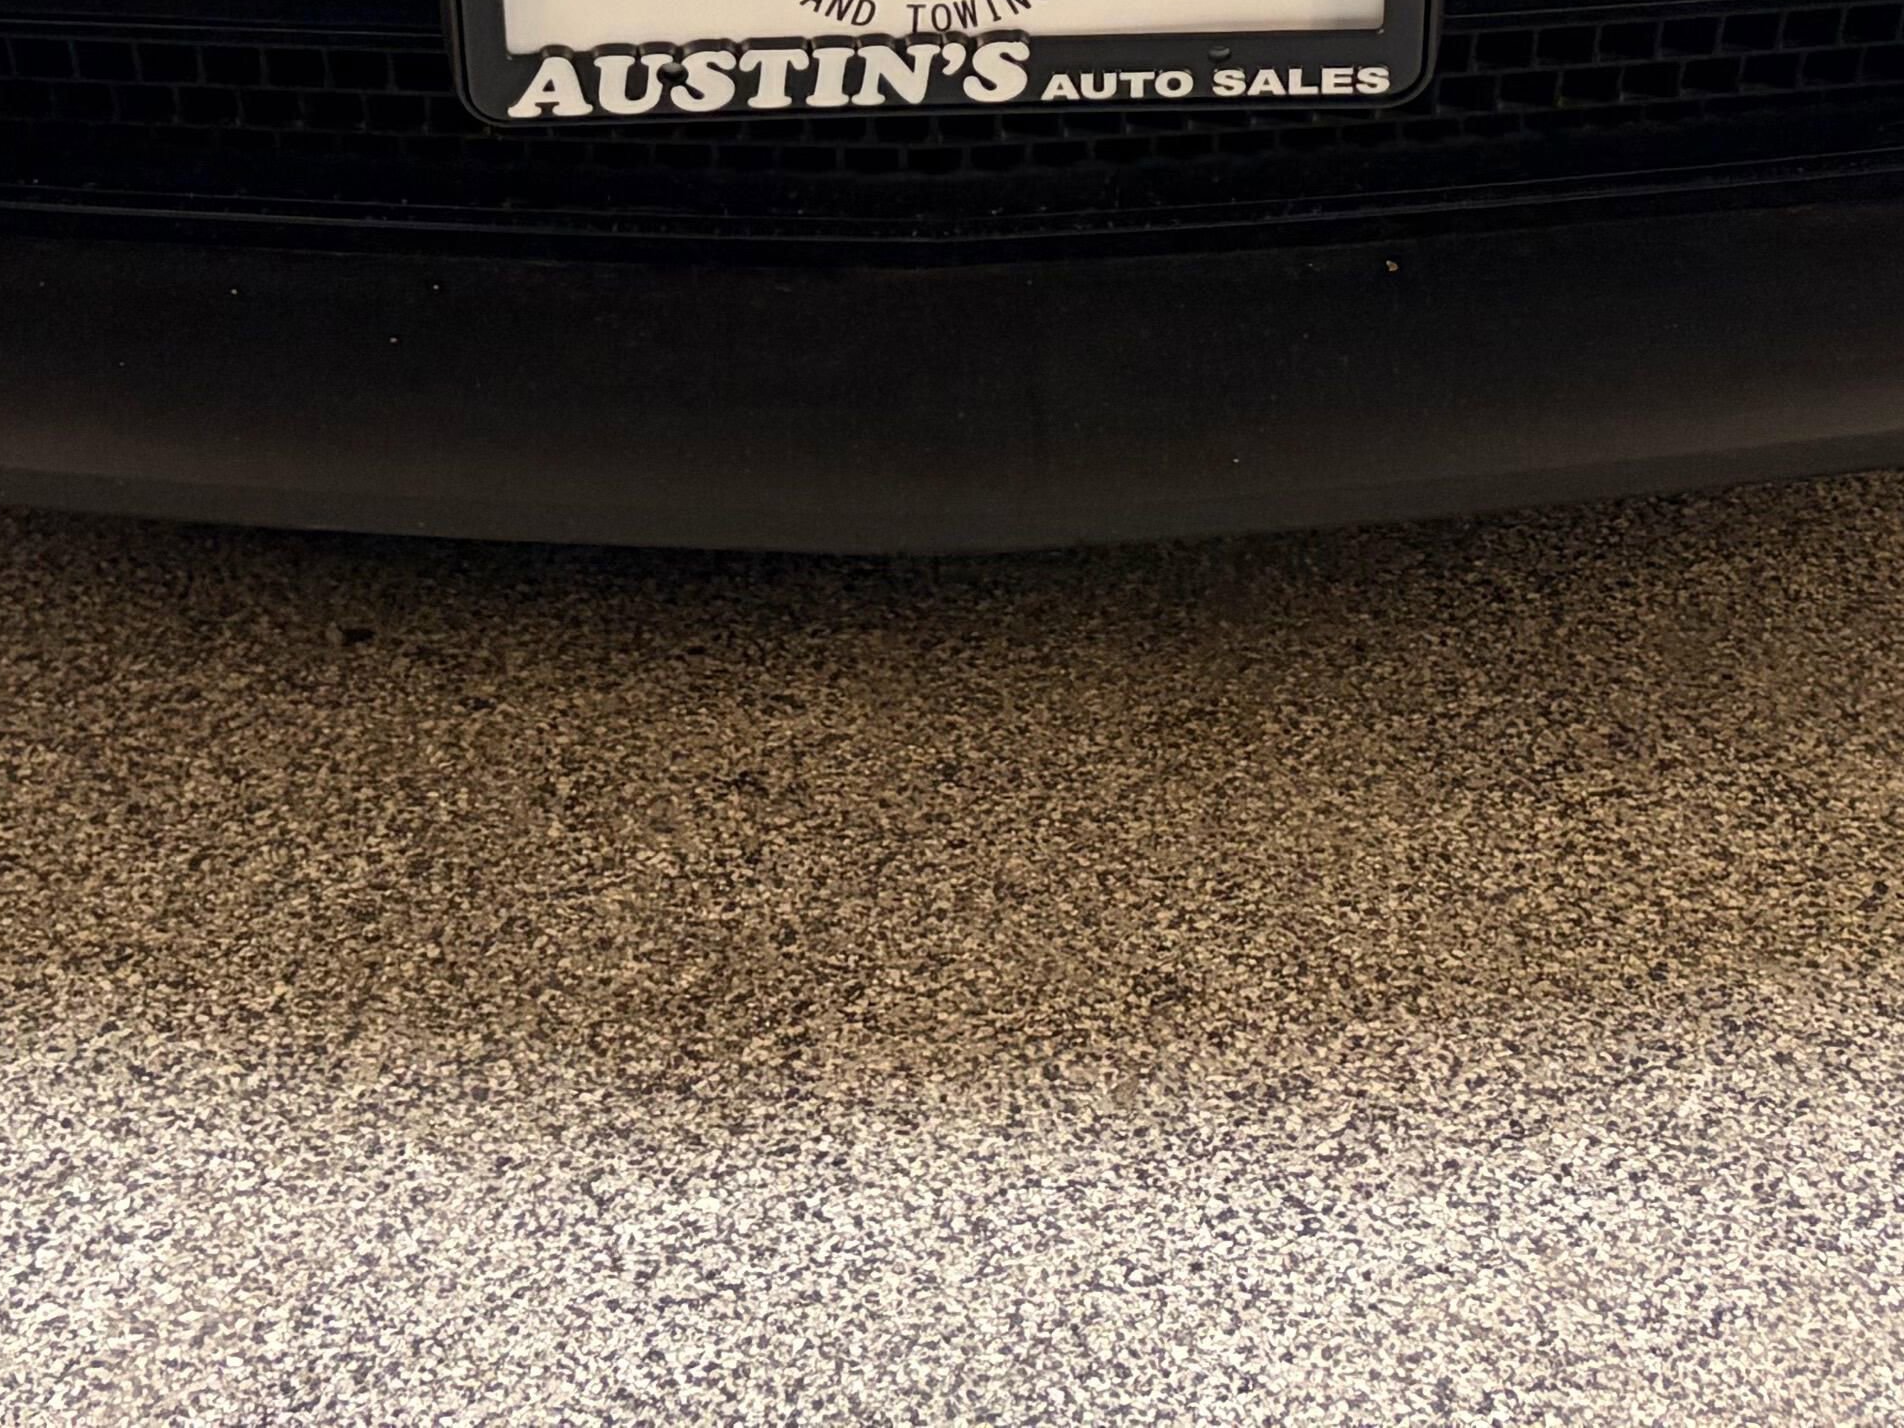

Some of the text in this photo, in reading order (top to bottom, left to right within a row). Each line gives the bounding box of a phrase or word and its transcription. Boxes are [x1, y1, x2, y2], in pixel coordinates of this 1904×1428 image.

[507, 41, 1391, 118] AUSTIN'S AUTO SALES
